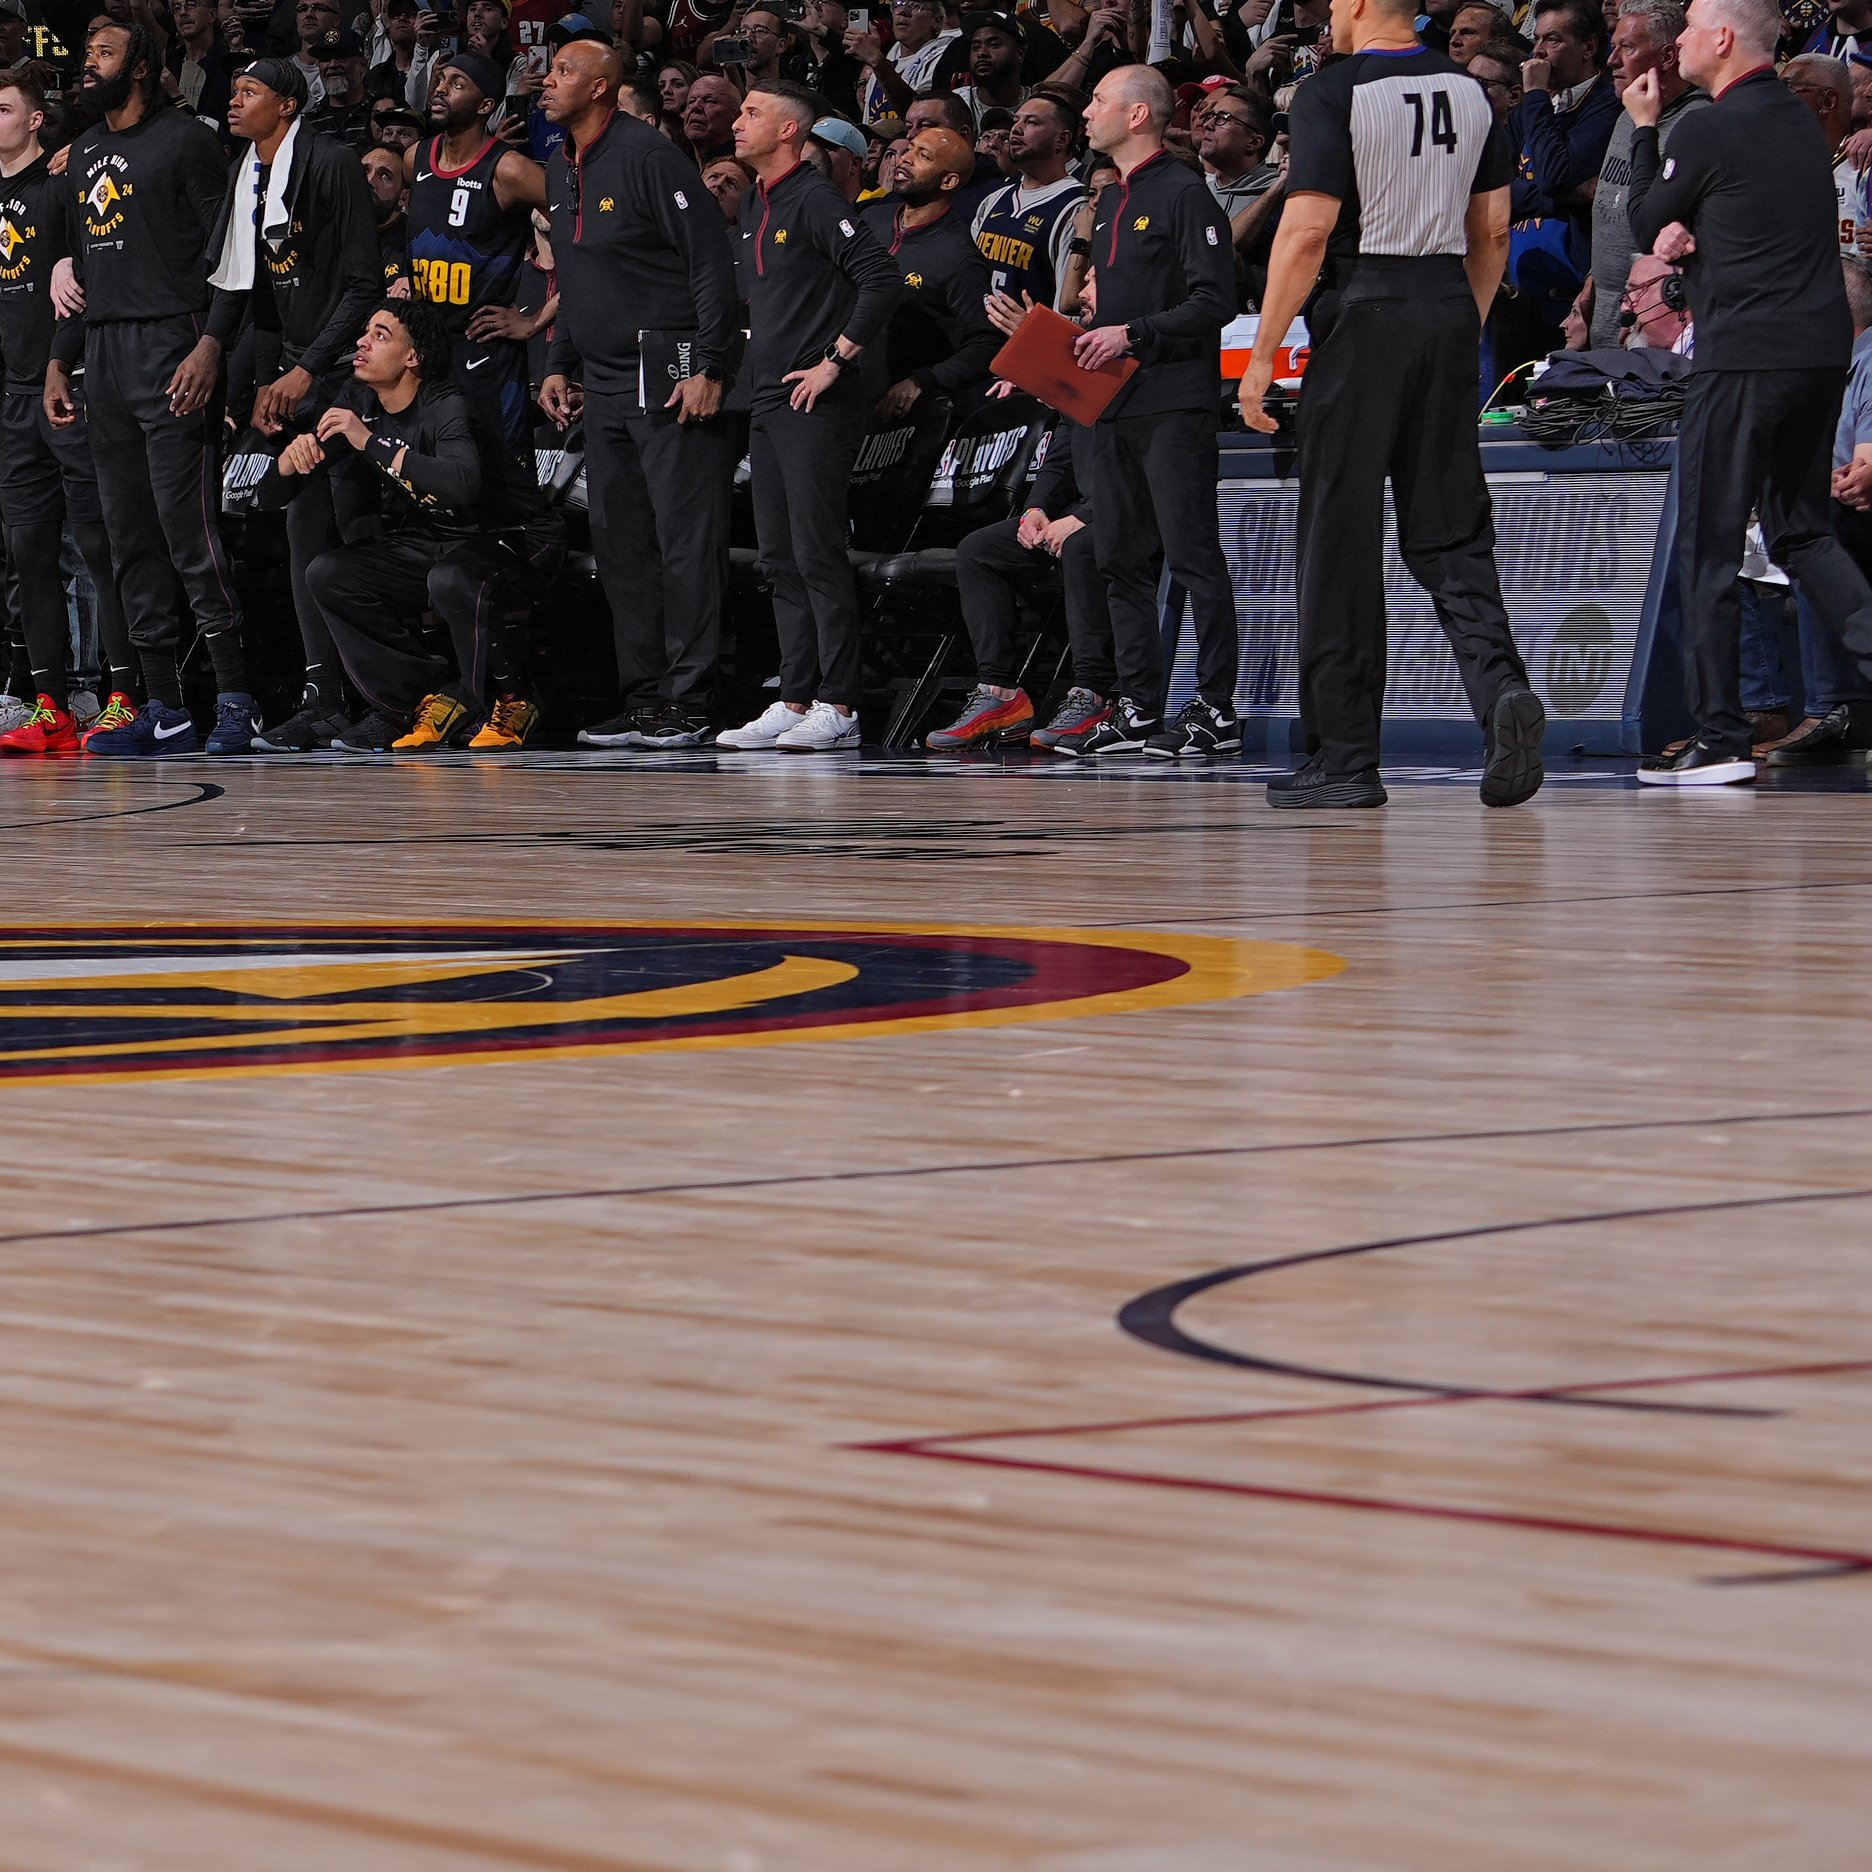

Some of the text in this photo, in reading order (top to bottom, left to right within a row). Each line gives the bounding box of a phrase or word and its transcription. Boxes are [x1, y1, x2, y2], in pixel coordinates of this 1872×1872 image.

[518, 19, 545, 43] 27
[1404, 91, 1458, 156] 74
[86, 154, 130, 180] MILE HIGH
[122, 183, 134, 196] 24
[457, 178, 483, 190] ibotta
[448, 189, 470, 227] 9
[24, 226, 36, 240] 24
[85, 212, 124, 237] PLAYOFFS
[293, 221, 303, 234] 24
[977, 228, 1036, 270] DENVER
[412, 258, 472, 305] 5280
[679, 342, 692, 382] LDING
[852, 426, 915, 472] LAYOFFS
[948, 425, 1028, 477] PLAYOFFS
